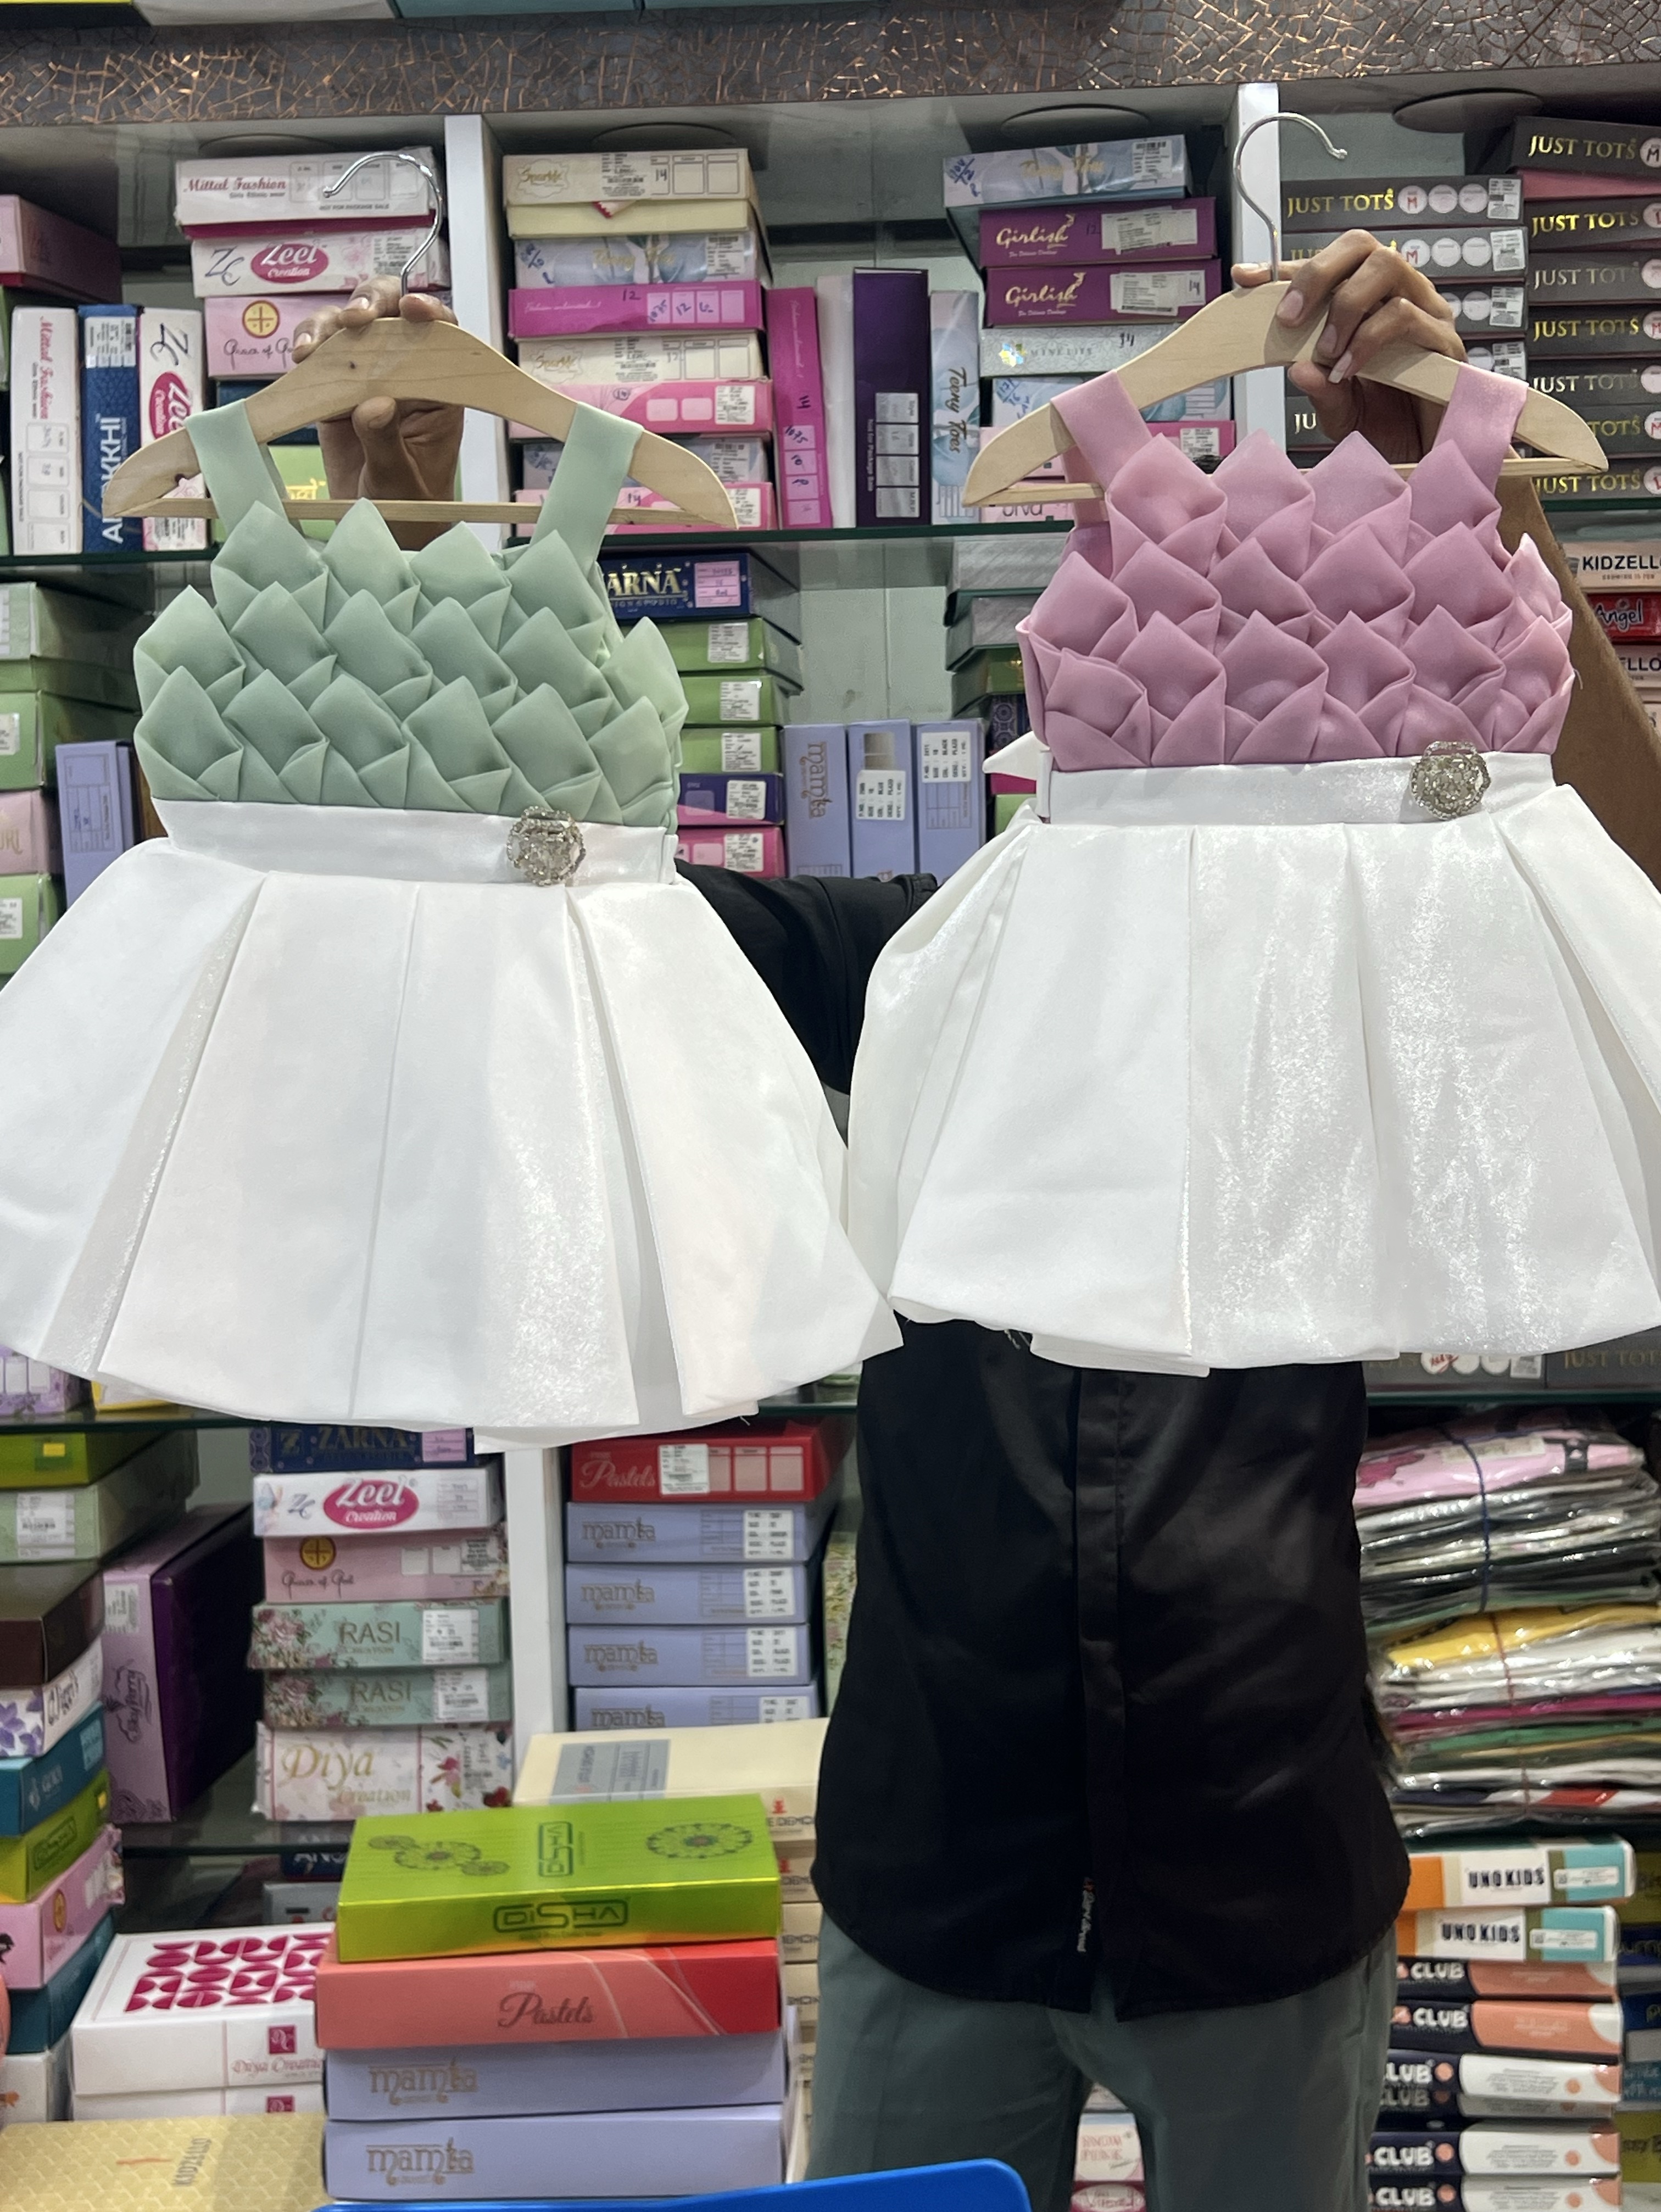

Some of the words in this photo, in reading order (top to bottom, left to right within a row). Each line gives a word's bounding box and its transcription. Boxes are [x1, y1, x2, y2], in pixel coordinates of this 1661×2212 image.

[1529, 135, 1578, 157] JUST
[1582, 138, 1636, 159] TOTS
[1647, 147, 1660, 161] M
[183, 178, 228, 192] Mittal
[233, 177, 286, 190] Fashion
[655, 168, 667, 182] 14
[1287, 194, 1334, 218] JUST
[1339, 190, 1395, 212] TOTS
[1407, 197, 1418, 209] M
[996, 214, 1074, 249] Girlish
[1532, 214, 1580, 237] JUST
[1584, 211, 1639, 230] TOTS
[261, 241, 319, 266] Zeel
[1406, 250, 1418, 264] M
[1006, 273, 1085, 307] Girlish
[1534, 269, 1581, 290] JUST
[622, 291, 642, 302] 12
[677, 303, 691, 316] 12
[40, 315, 53, 363] Mittal
[1533, 320, 1581, 342] JUST
[1586, 318, 1639, 336] TOTS
[275, 338, 293, 369] Go
[40, 367, 53, 419] Fashion
[945, 367, 967, 413] Teeny
[1533, 376, 1579, 393] JUST
[169, 381, 192, 431] Zee
[797, 395, 811, 409] 14
[949, 420, 967, 454] Toes
[1587, 416, 1641, 436] TOTS
[101, 417, 124, 544] AKKHI
[1535, 476, 1581, 494] JUST
[1586, 471, 1641, 492] TOTS
[1582, 555, 1661, 571] KIDZELL
[606, 569, 682, 596] ARNA
[1596, 600, 1643, 631] Angel
[799, 742, 833, 818] mamta
[1564, 1350, 1609, 1369] JUST
[579, 1459, 656, 1489] Pastels
[336, 1475, 406, 1507] Zeel
[582, 1517, 656, 1549] mamta
[580, 1579, 655, 1611] mamta
[338, 1621, 400, 1644] RASI
[584, 1640, 658, 1673] mamta
[350, 1680, 412, 1702] RASI
[590, 1704, 666, 1728] mamta
[280, 1741, 373, 1790] Diya
[1505, 1867, 1545, 1886] KIDS
[1481, 1924, 1520, 1943] KIDS
[1411, 1961, 1464, 1979] CLUB
[497, 1992, 593, 2028] Pastels
[1413, 2008, 1468, 2028] CLUB
[368, 2057, 479, 2105] mamta
[366, 2137, 475, 2186] mamta
[1374, 2146, 1434, 2166] CLUB
[1375, 2187, 1436, 2207] CLUB
